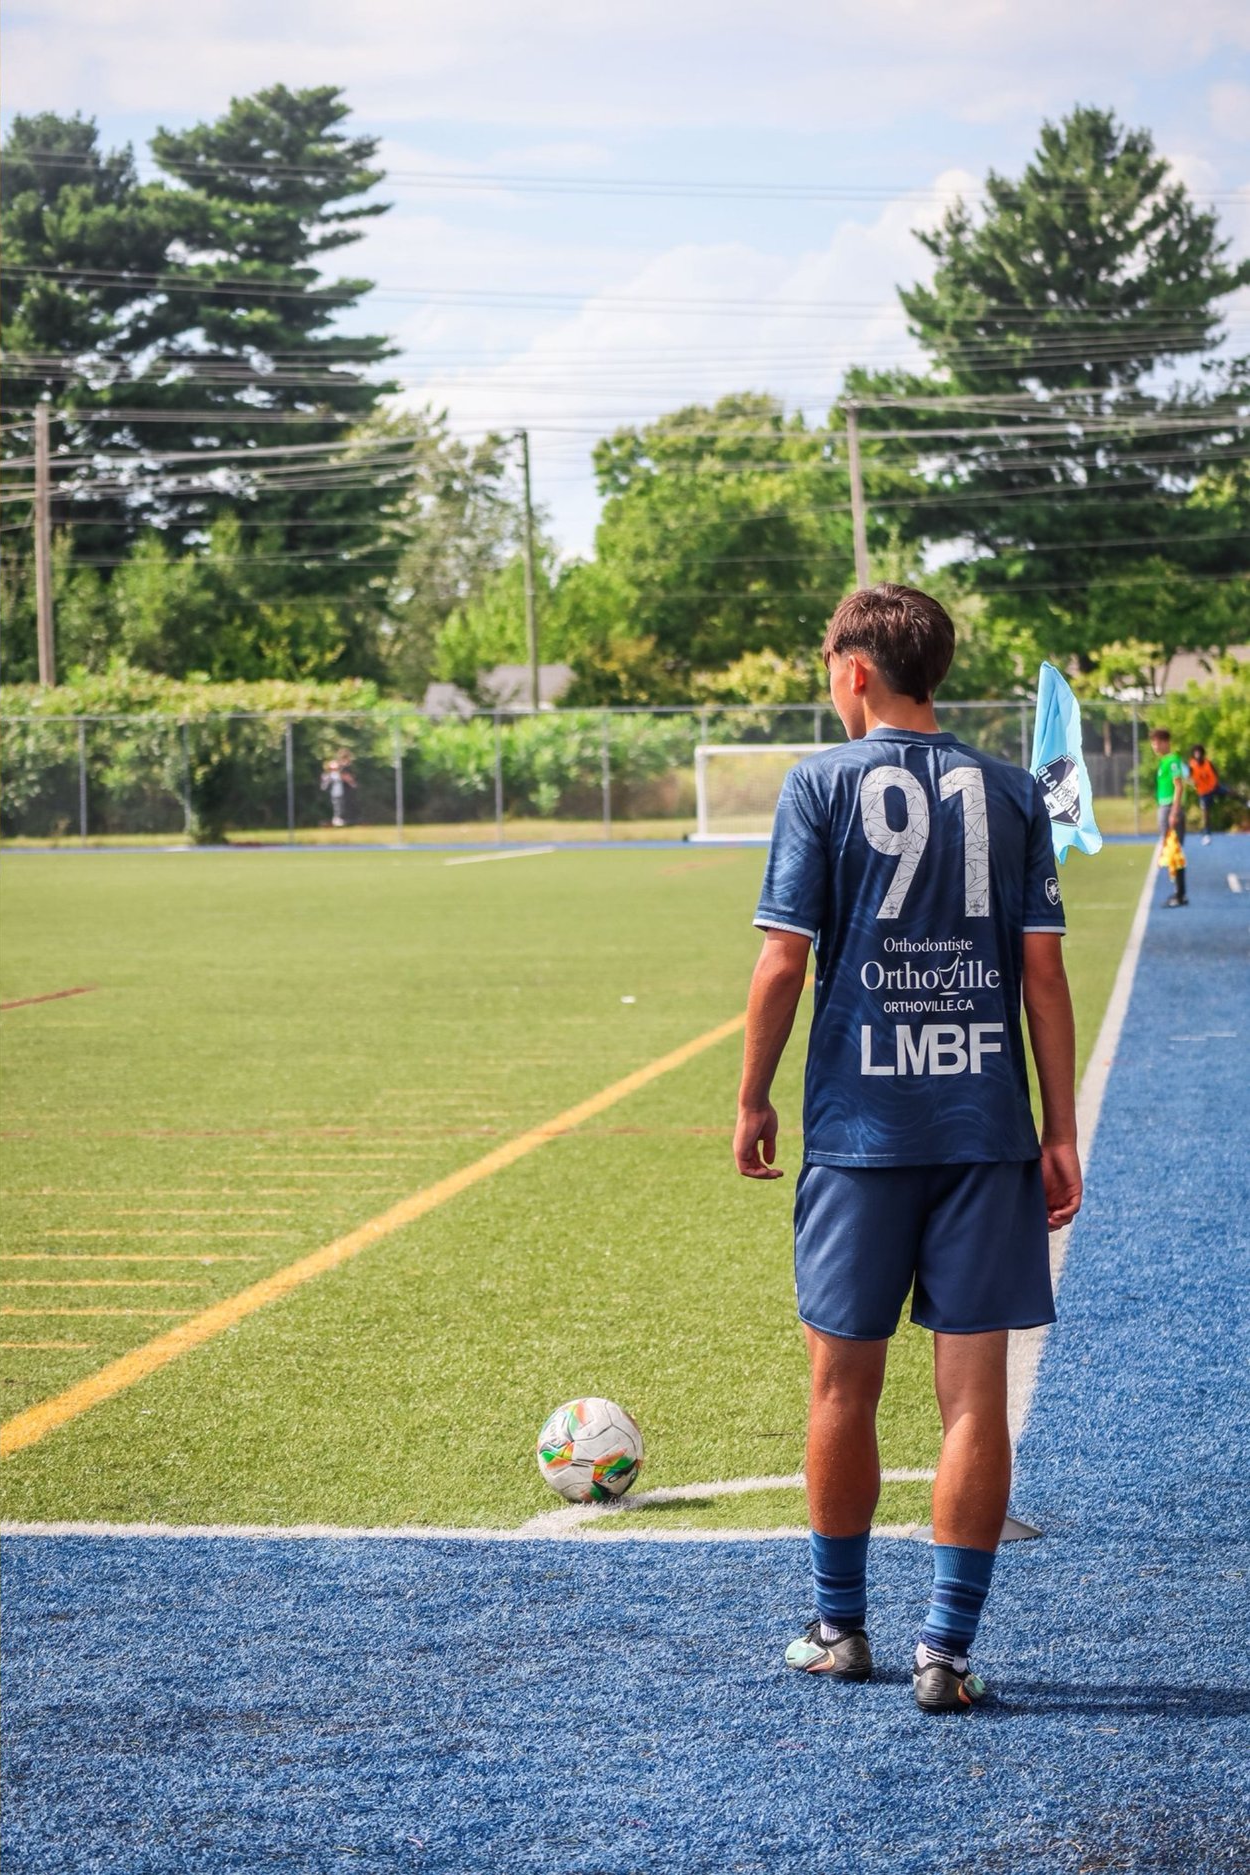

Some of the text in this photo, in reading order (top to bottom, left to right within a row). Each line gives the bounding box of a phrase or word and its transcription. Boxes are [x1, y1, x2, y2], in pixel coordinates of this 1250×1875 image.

[860, 765, 990, 919] 91
[883, 936, 973, 953] Orthodontiste
[883, 999, 975, 1013] ORTHOVILLE.CA
[860, 1022, 1004, 1076] LMBF
